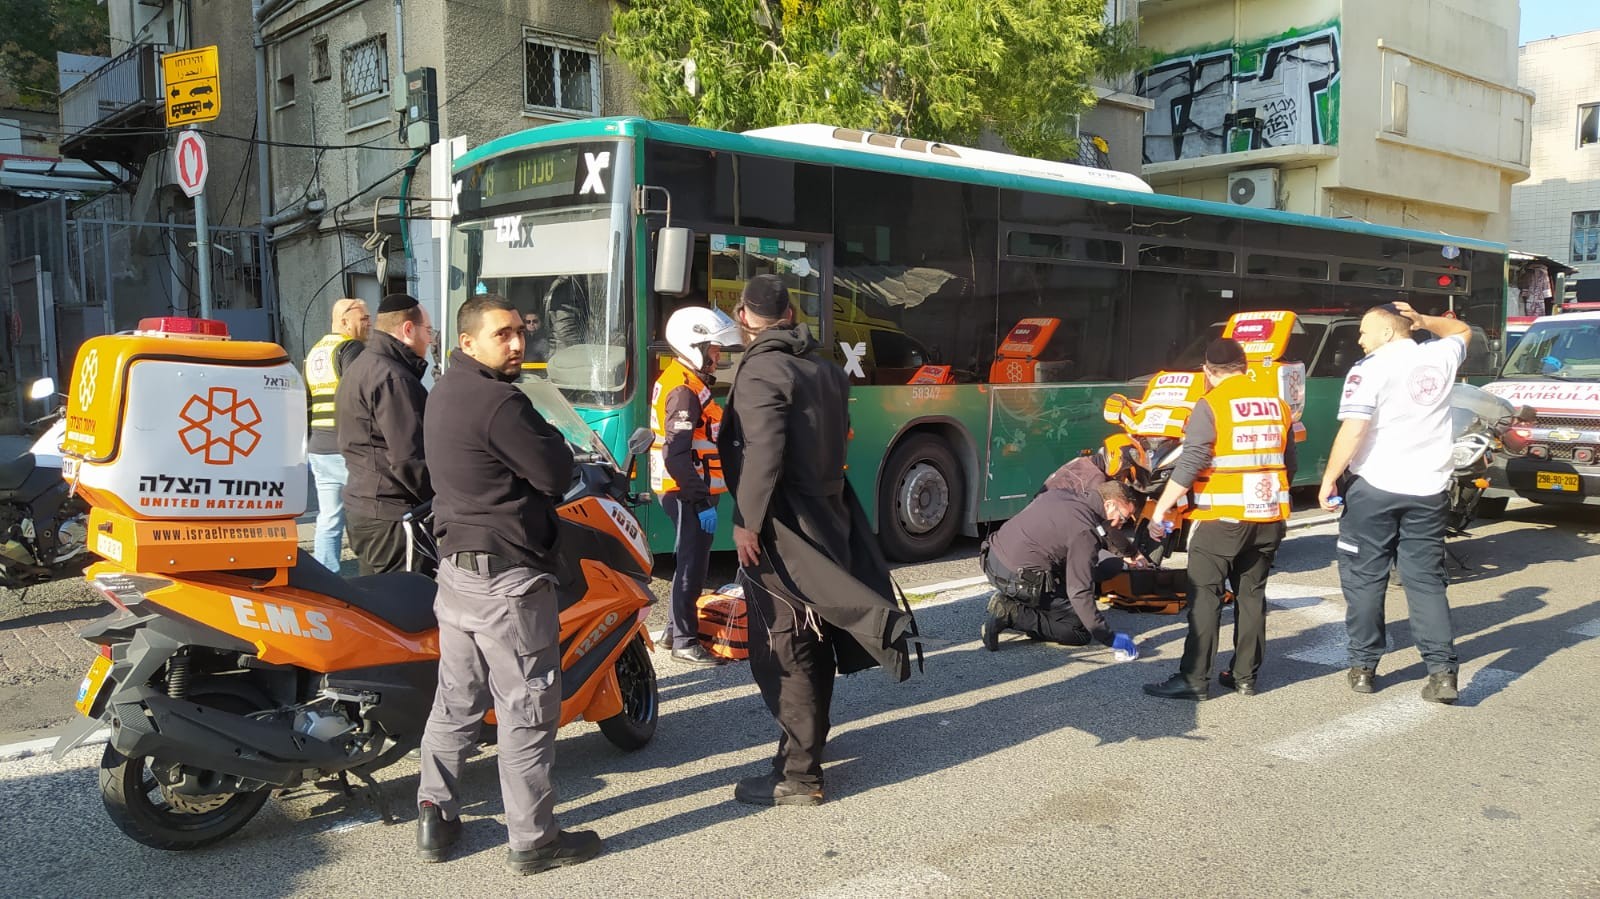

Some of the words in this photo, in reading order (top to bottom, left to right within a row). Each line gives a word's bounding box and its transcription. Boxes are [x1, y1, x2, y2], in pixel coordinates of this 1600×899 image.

[263, 375, 290, 387] הראל
[1158, 375, 1189, 384] חובש
[1235, 402, 1279, 417] חובש
[139, 474, 211, 495] הצלה
[218, 479, 285, 497] איחוד
[140, 497, 200, 508] UNITED
[206, 499, 284, 510] HATZALAH
[152, 526, 286, 540] www.israelrescue.org
[230, 595, 333, 641] E.M.S
